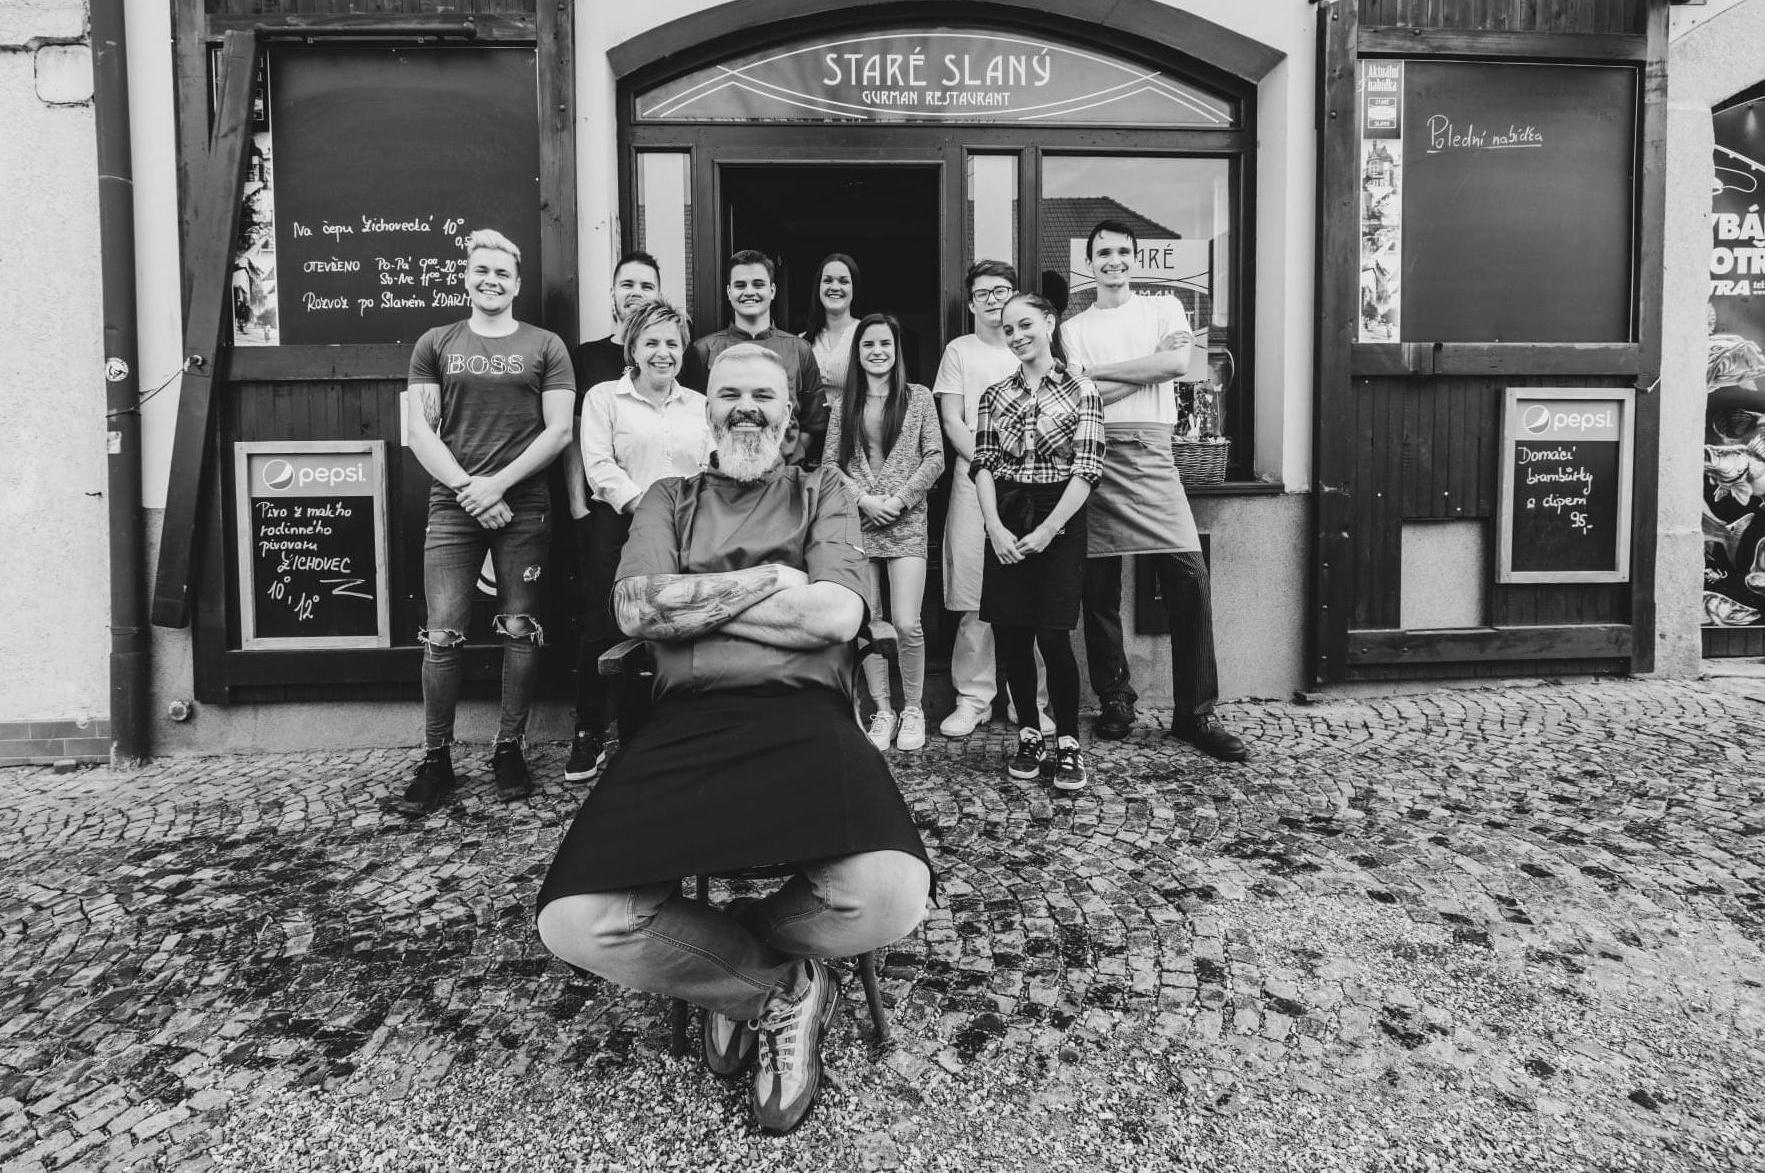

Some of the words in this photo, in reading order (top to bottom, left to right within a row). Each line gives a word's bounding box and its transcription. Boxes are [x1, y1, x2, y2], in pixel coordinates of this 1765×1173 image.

[823, 46, 927, 86] STARÉ
[941, 47, 1050, 86] SLANÝ
[862, 90, 918, 105] GURMAN
[926, 91, 1011, 106] RESTAURANT
[1427, 114, 1487, 149] Polední
[1492, 124, 1543, 146] nabídka
[293, 221, 313, 239] Na
[322, 220, 354, 243] čepu
[303, 256, 361, 273] OTEVŘENO
[302, 291, 349, 312] Rozvoz
[357, 298, 375, 317] po
[380, 291, 426, 309] Slaném
[431, 289, 471, 308] ZDARM
[446, 353, 525, 375] BOSS
[1553, 409, 1613, 432] pepsi
[1517, 445, 1577, 465] Domácí
[299, 462, 366, 487] pepsi
[256, 501, 288, 518] Pivo
[1542, 493, 1587, 515] dipem
[260, 520, 333, 537] rodinného
[259, 538, 318, 558] pivovaru
